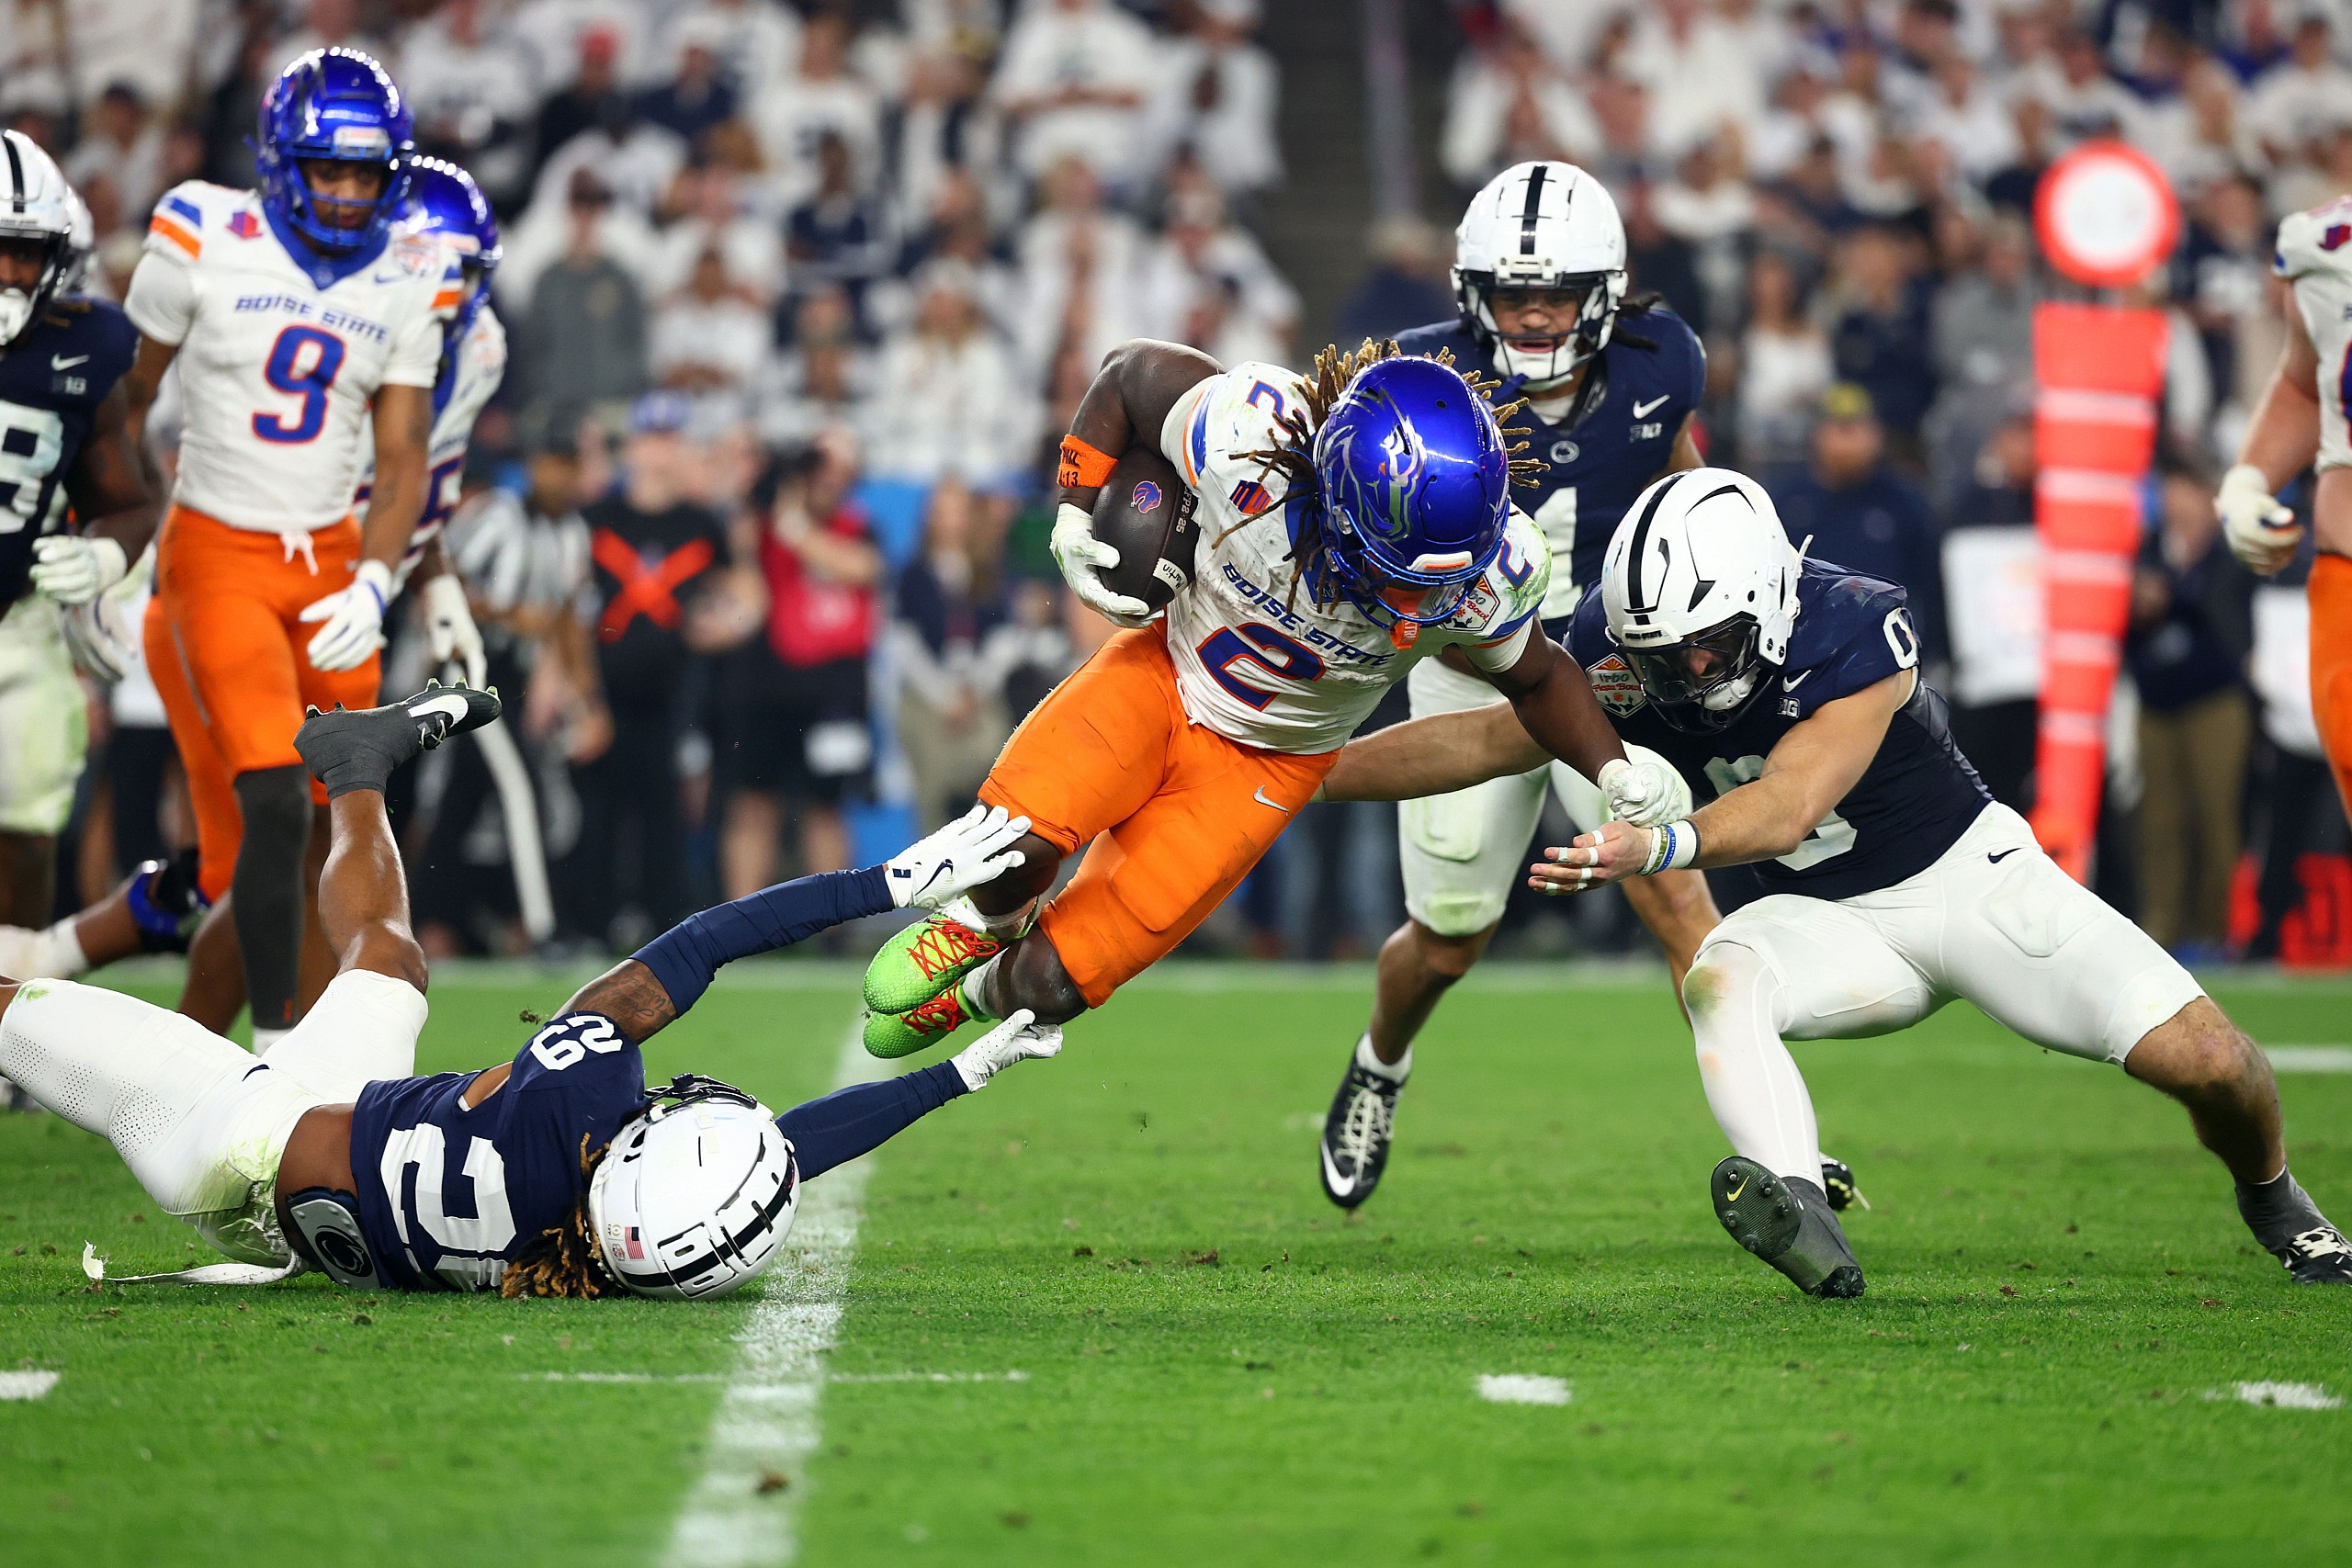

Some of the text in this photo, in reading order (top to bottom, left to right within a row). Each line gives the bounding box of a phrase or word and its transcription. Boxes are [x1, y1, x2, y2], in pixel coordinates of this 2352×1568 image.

[234, 294, 390, 343] BOISE STATE
[252, 321, 347, 446] 9
[1162, 563, 1185, 589] Martin
[1533, 486, 1582, 620] 1
[1222, 560, 1396, 669] BOISE STATE
[1883, 607, 1918, 670] 0
[1195, 621, 1326, 713] 2
[529, 1015, 624, 1072] 29
